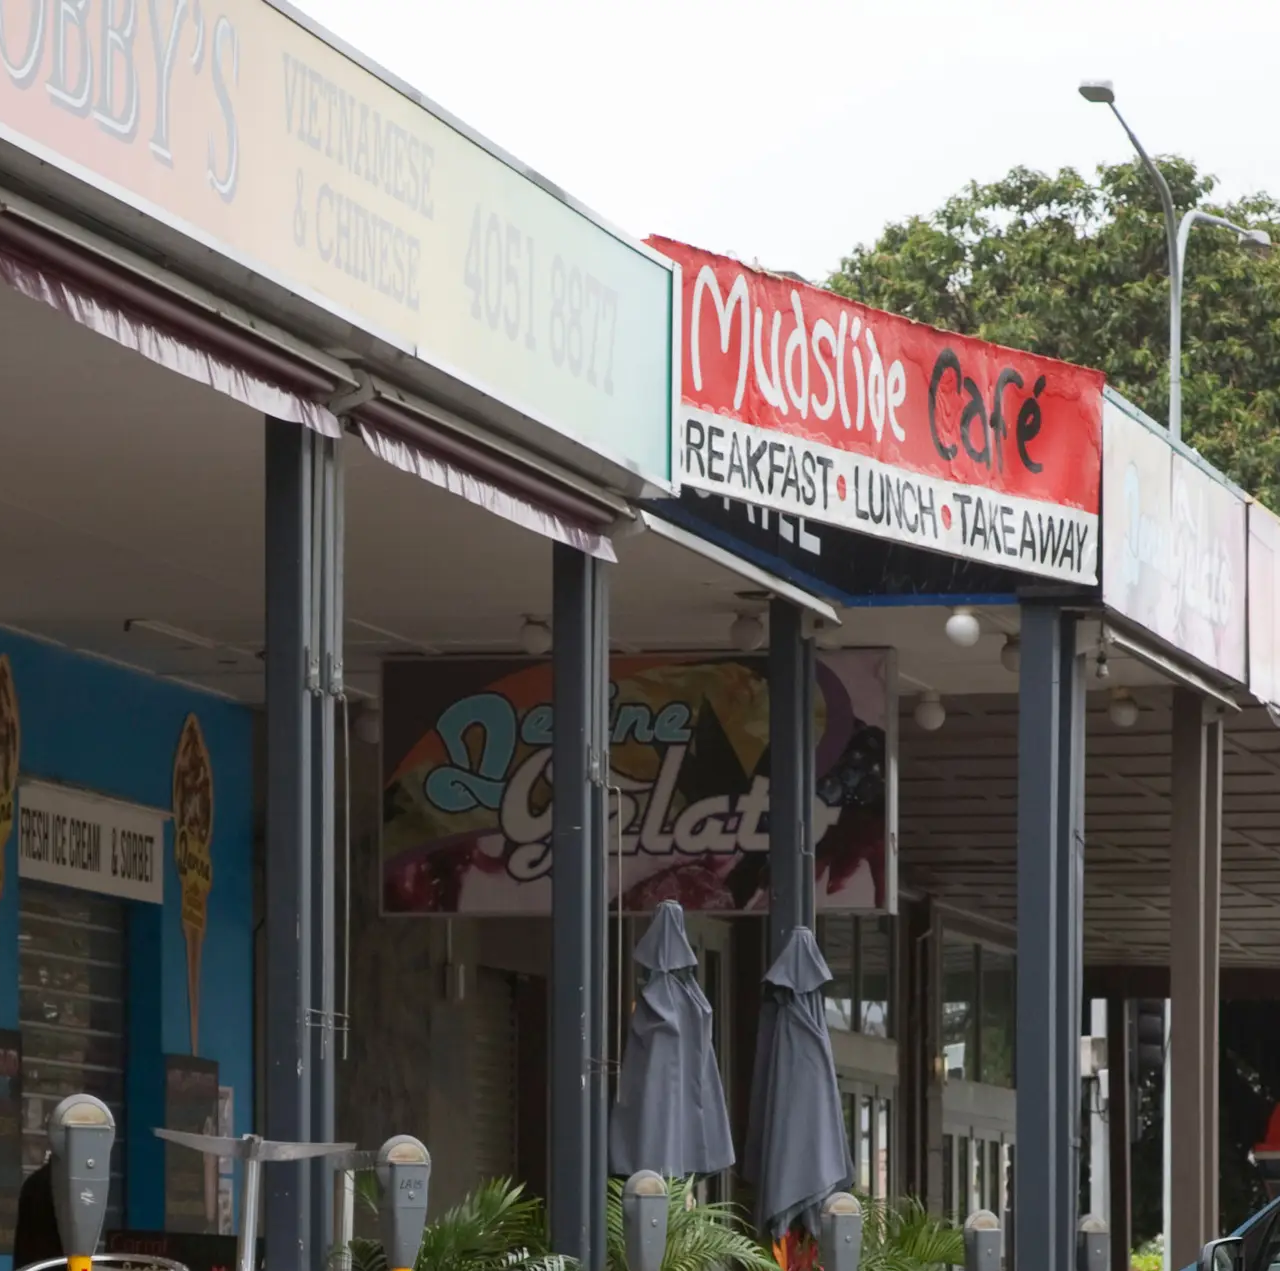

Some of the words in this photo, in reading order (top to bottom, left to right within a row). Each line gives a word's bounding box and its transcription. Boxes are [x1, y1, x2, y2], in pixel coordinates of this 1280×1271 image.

[282, 52, 436, 218] VIETNAMESE
[294, 170, 308, 246] &
[315, 190, 420, 311] CHINESE
[464, 203, 537, 353] 4051
[550, 254, 619, 395] 8877
[928, 347, 1046, 474] Café
[680, 418, 835, 510] REAKFAST
[853, 465, 938, 539] LUNCH
[953, 492, 1090, 574] TAKEAWAY
[20, 806, 49, 862] FRESH
[52, 812, 68, 866] ICE
[69, 818, 101, 873] CREAM
[120, 831, 156, 883] SORBET
